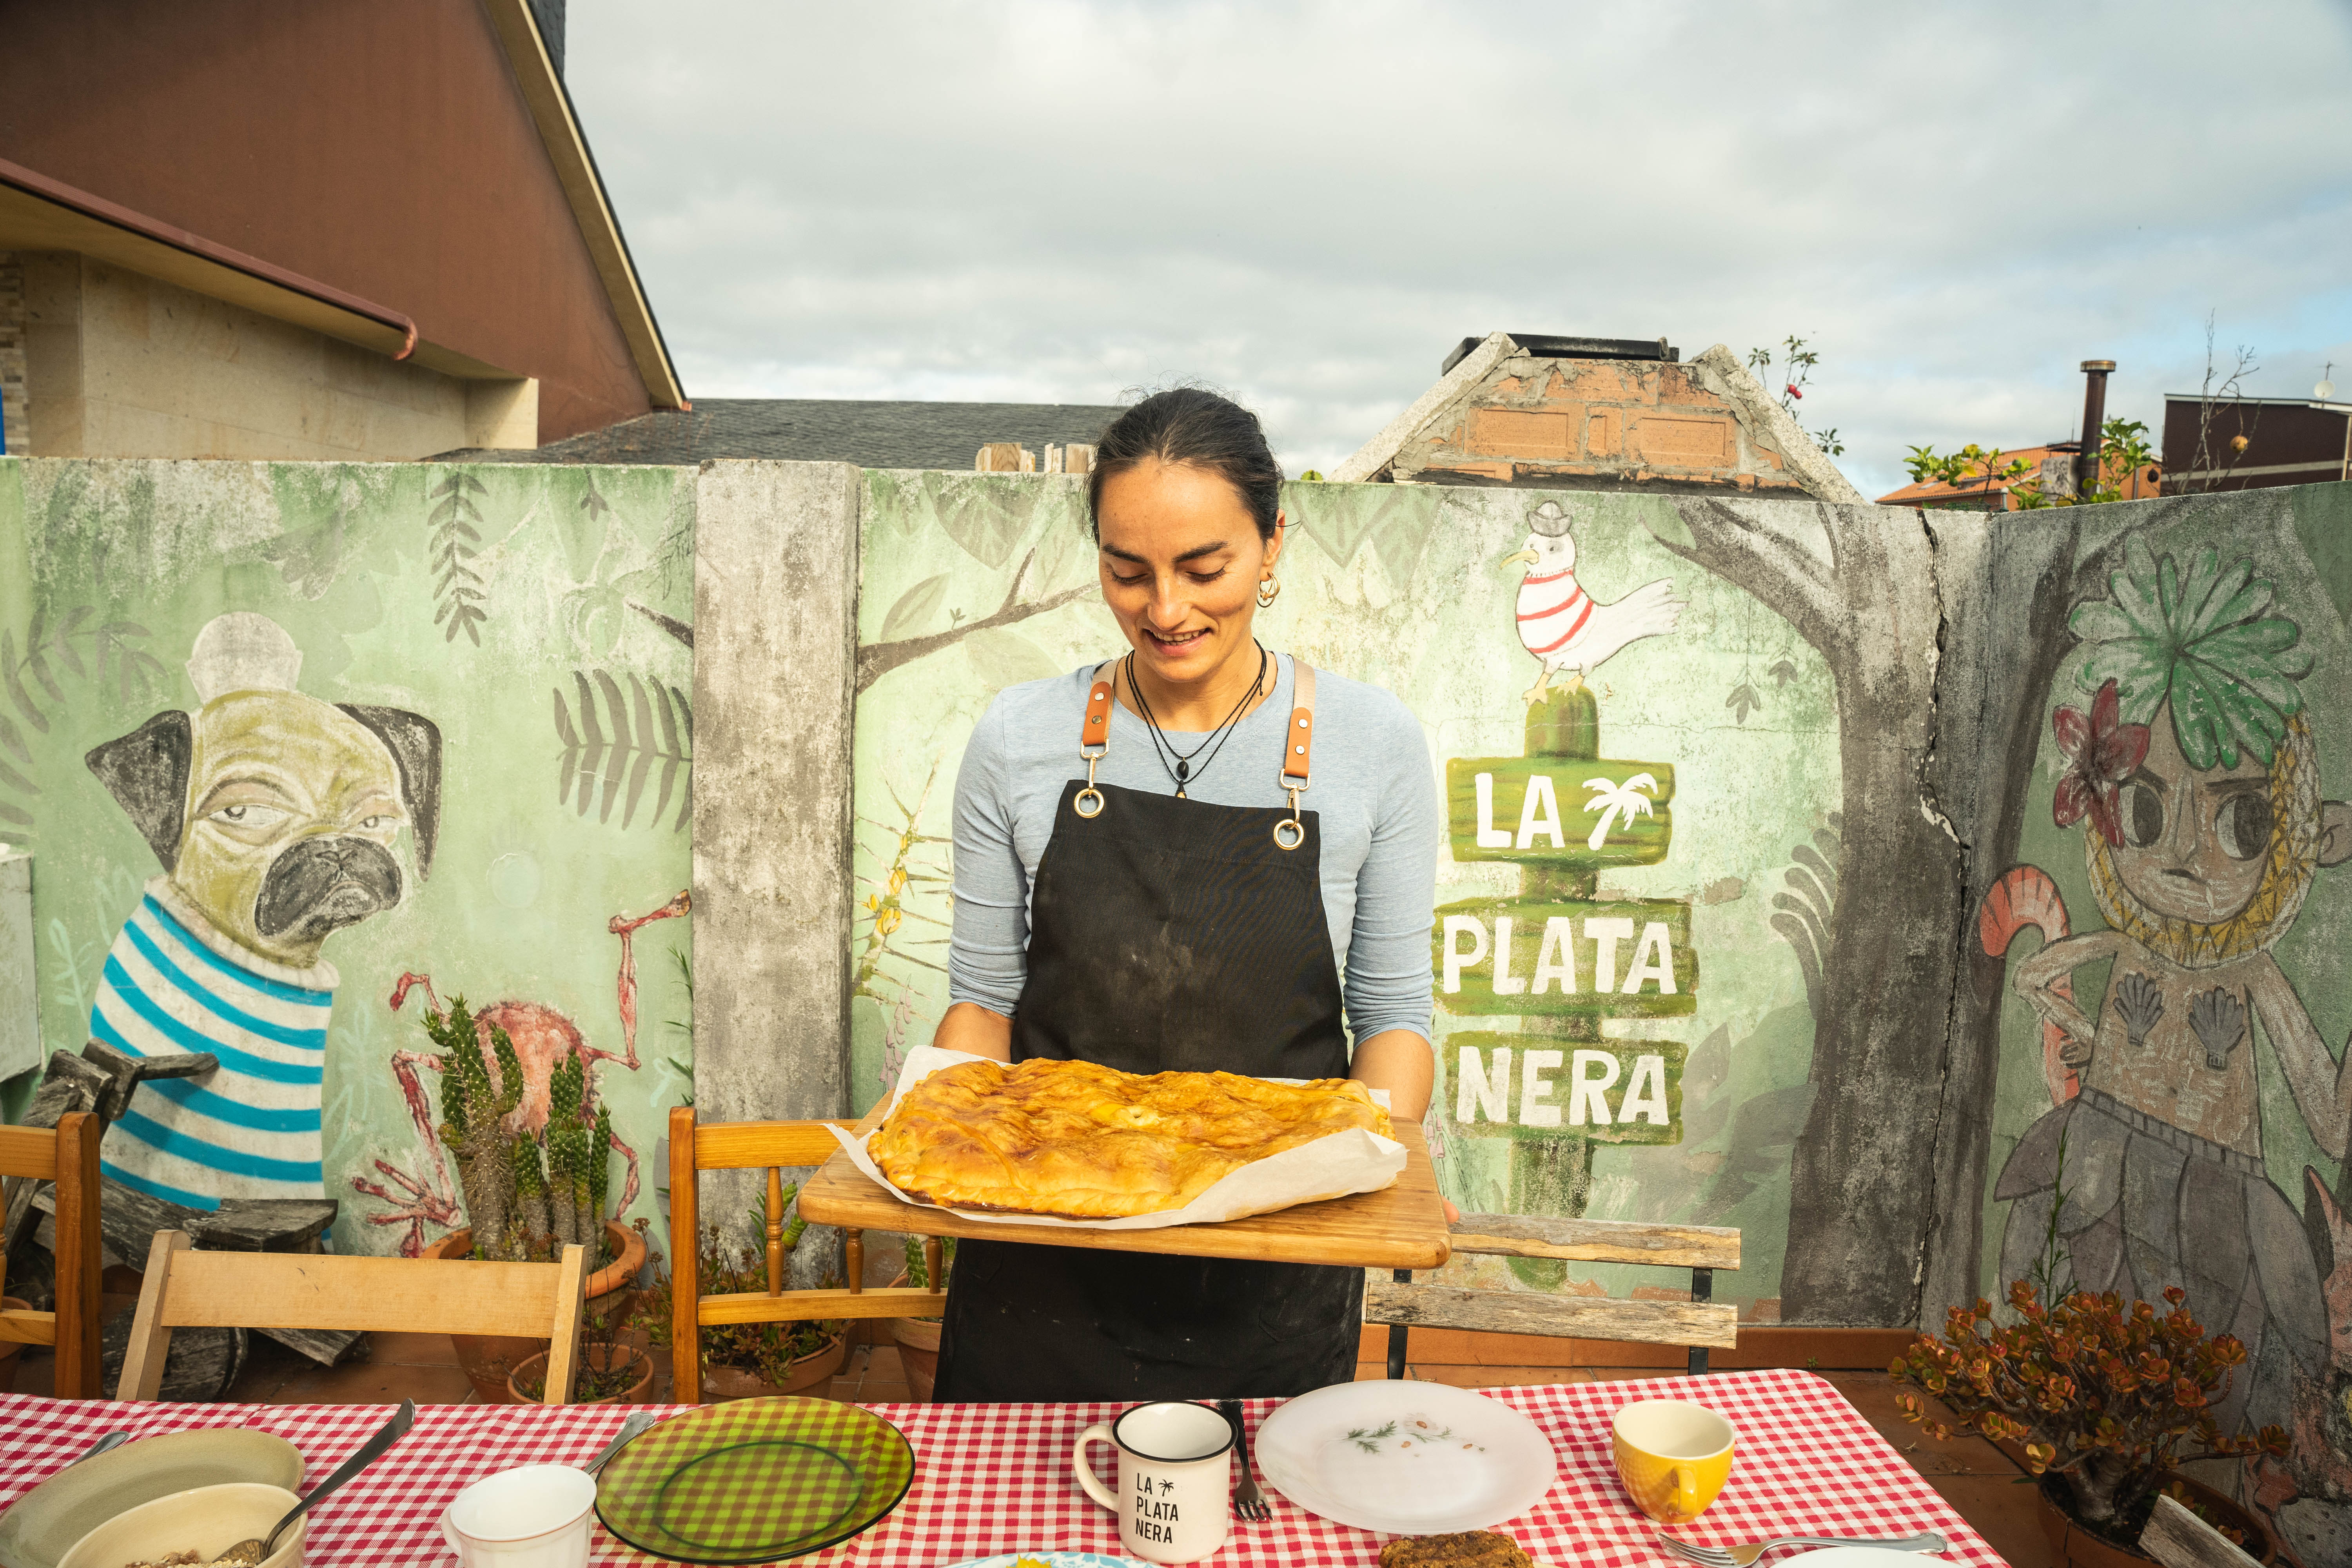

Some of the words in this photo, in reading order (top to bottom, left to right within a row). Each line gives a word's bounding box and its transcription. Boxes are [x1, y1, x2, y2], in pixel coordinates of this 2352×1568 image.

[1475, 772, 1566, 850] LA
[1443, 915, 1677, 995] PLATA
[1456, 1046, 1670, 1126] NERA
[1136, 1495, 1178, 1521] PLATA
[1137, 1472, 1152, 1495] LA
[1136, 1517, 1172, 1544] NERA
